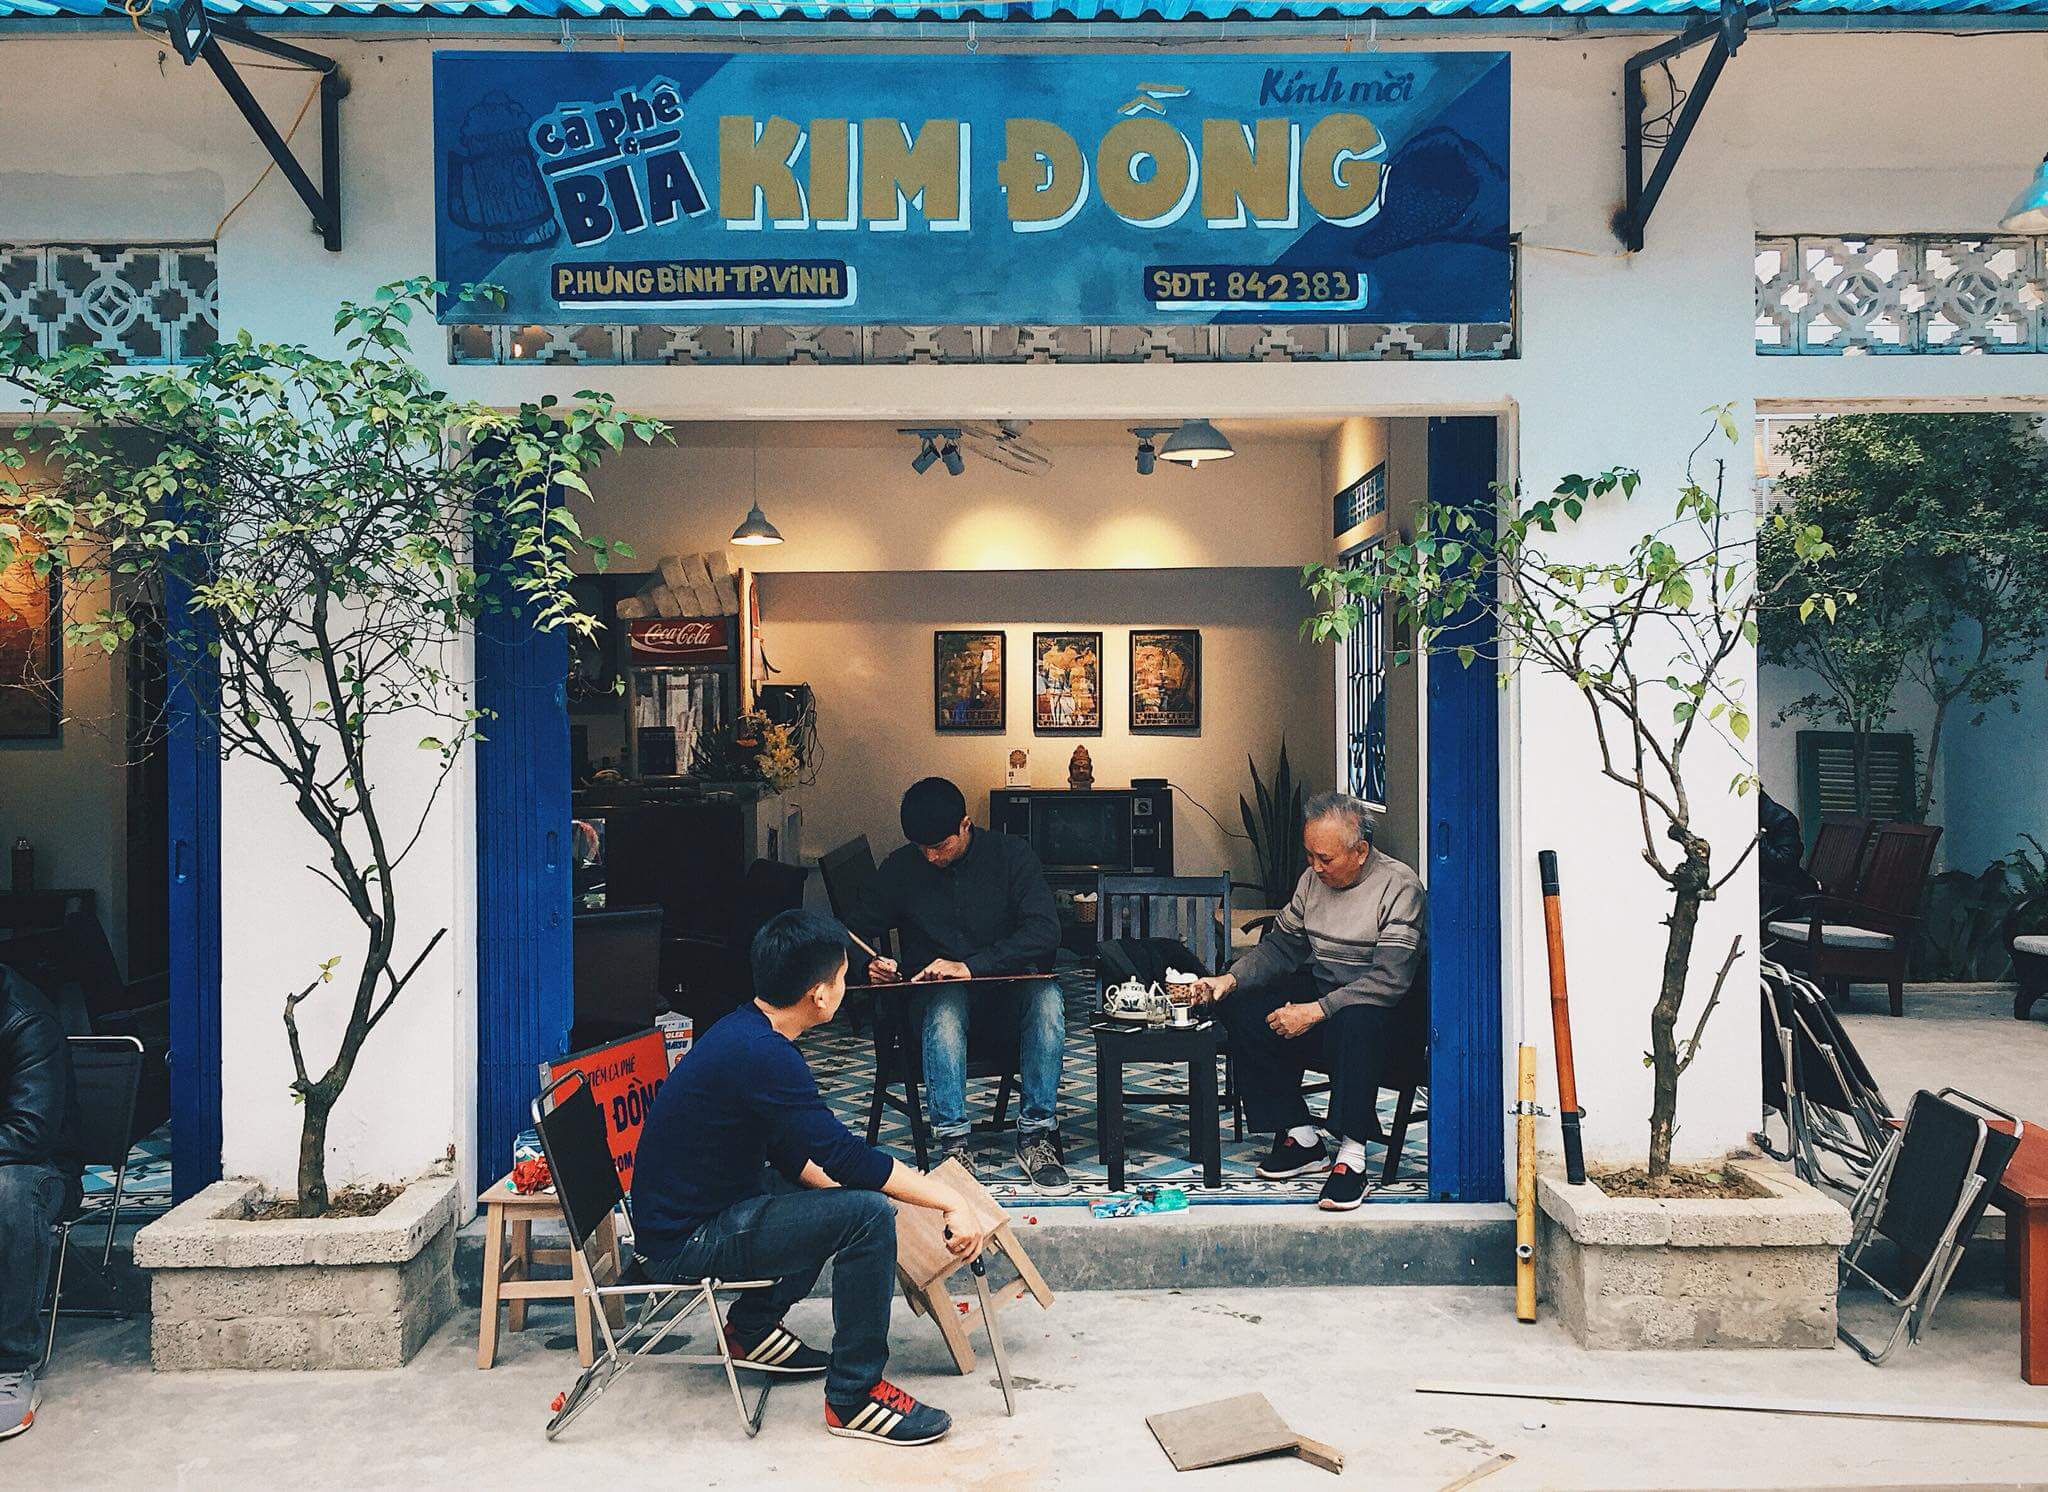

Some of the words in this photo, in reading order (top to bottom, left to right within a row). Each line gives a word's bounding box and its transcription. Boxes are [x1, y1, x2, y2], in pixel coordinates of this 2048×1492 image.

[594, 80, 685, 157] phê
[622, 136, 641, 156] &
[552, 150, 711, 248] BIA
[718, 115, 971, 232] KIM
[1153, 270, 1216, 298] SĐT:
[1227, 271, 1350, 300] 842383
